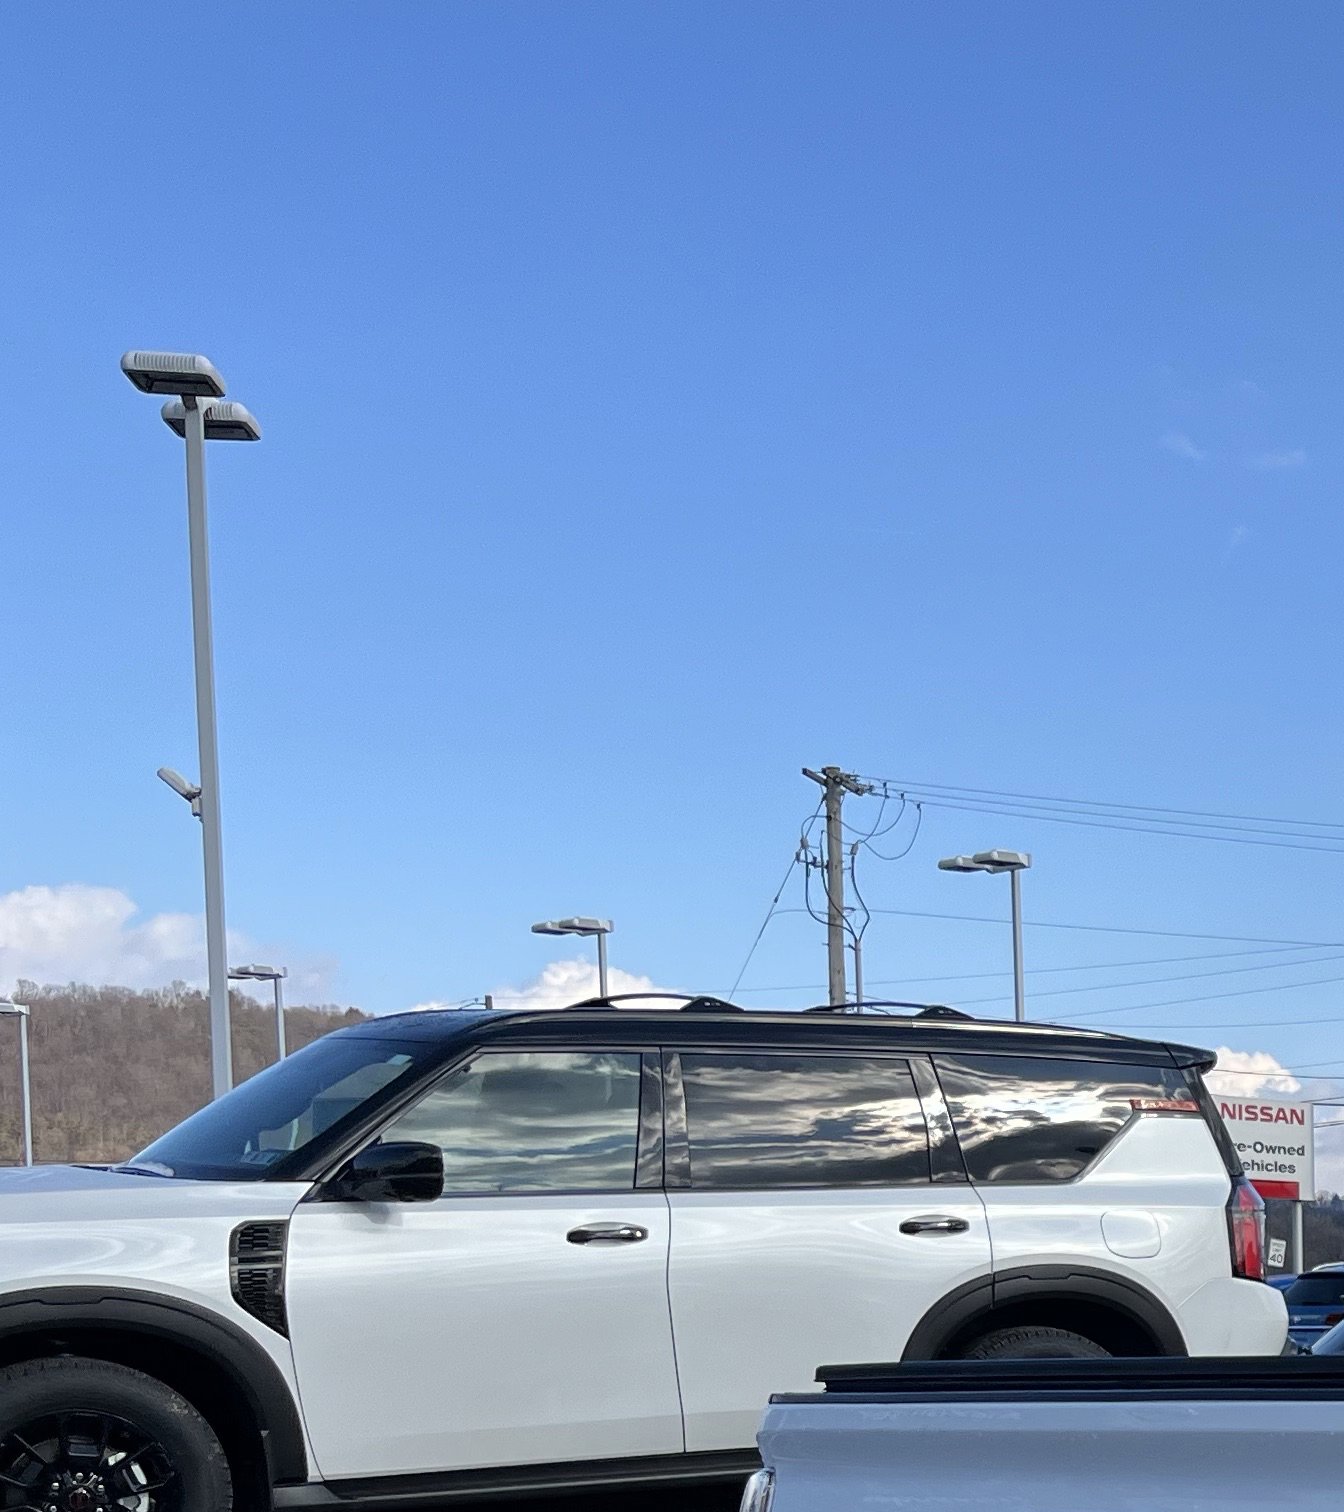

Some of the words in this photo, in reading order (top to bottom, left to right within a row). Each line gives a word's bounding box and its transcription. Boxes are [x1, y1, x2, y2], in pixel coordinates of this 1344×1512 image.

[1220, 1103, 1305, 1125] NISSAN
[1240, 1159, 1297, 1174] ehicles
[1269, 1253, 1284, 1265] 40
